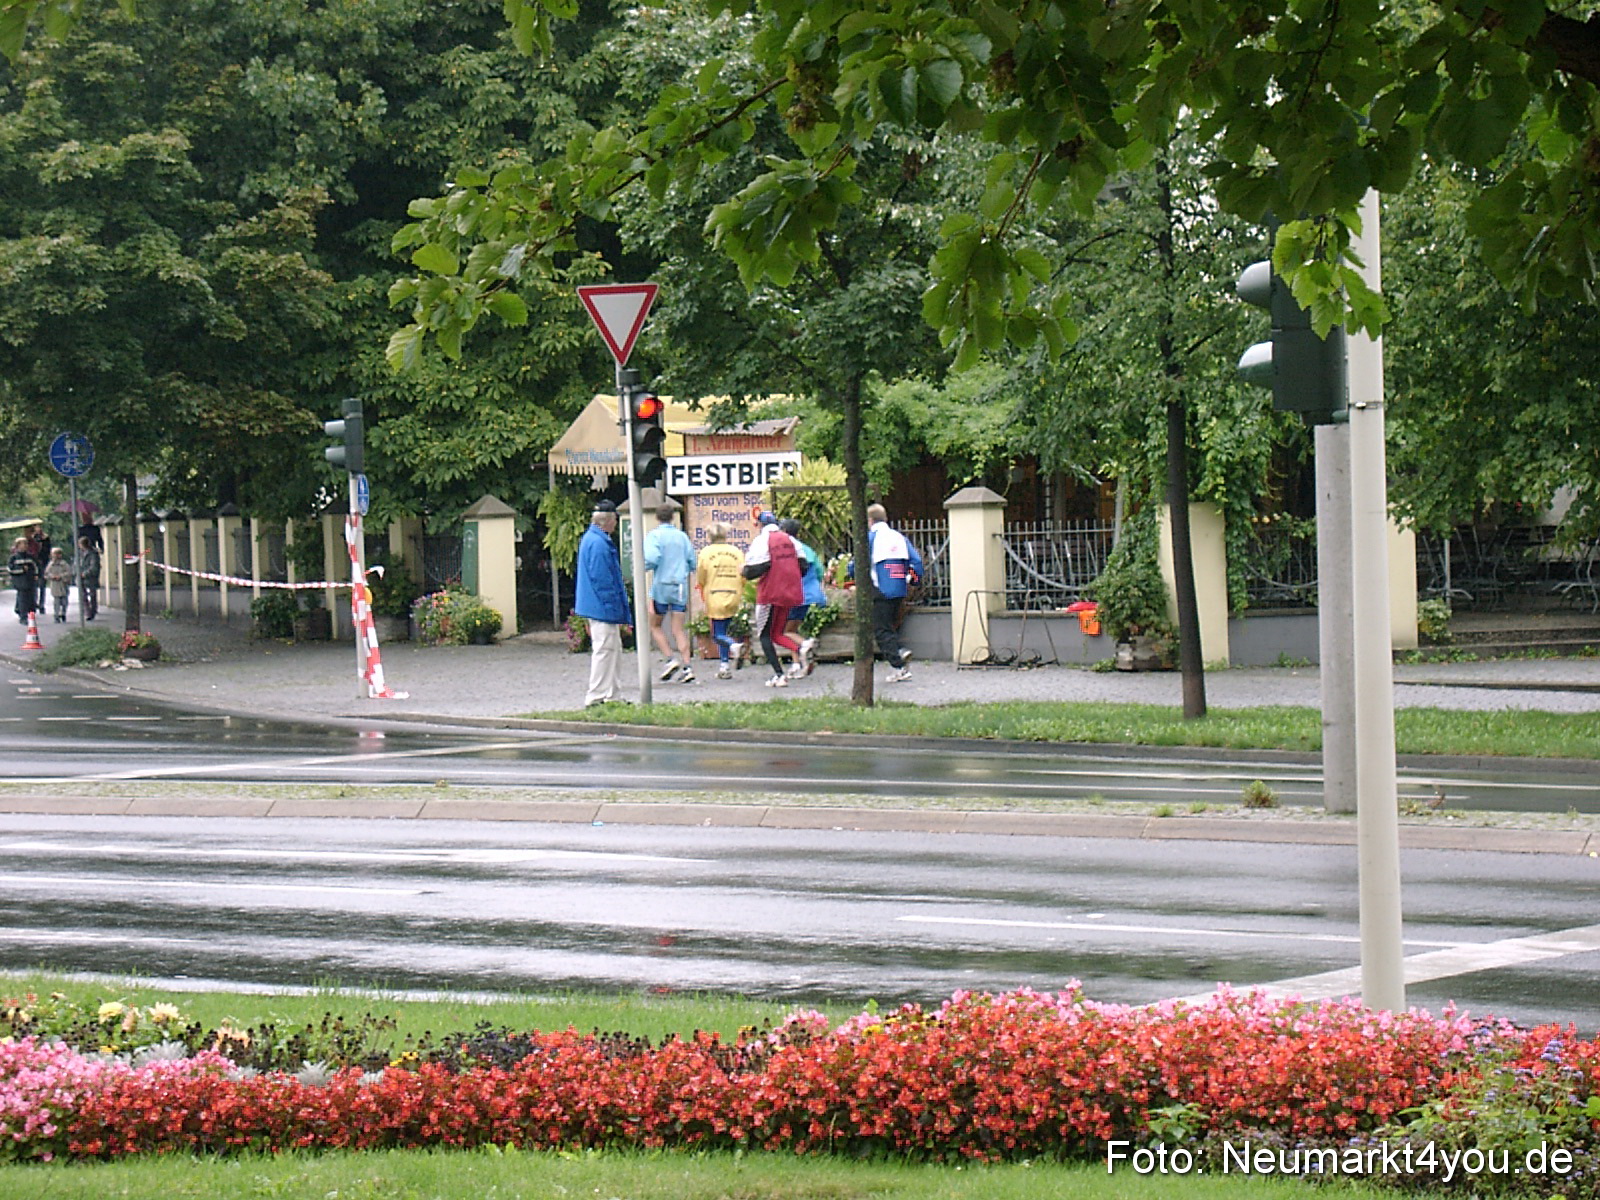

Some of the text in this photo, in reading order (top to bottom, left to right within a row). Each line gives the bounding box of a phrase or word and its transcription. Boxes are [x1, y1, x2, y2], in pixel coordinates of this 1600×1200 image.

[694, 494, 715, 507] Sau
[717, 497, 739, 507] vom
[711, 509, 751, 525] Ripperl
[695, 526, 750, 539] Breiten
